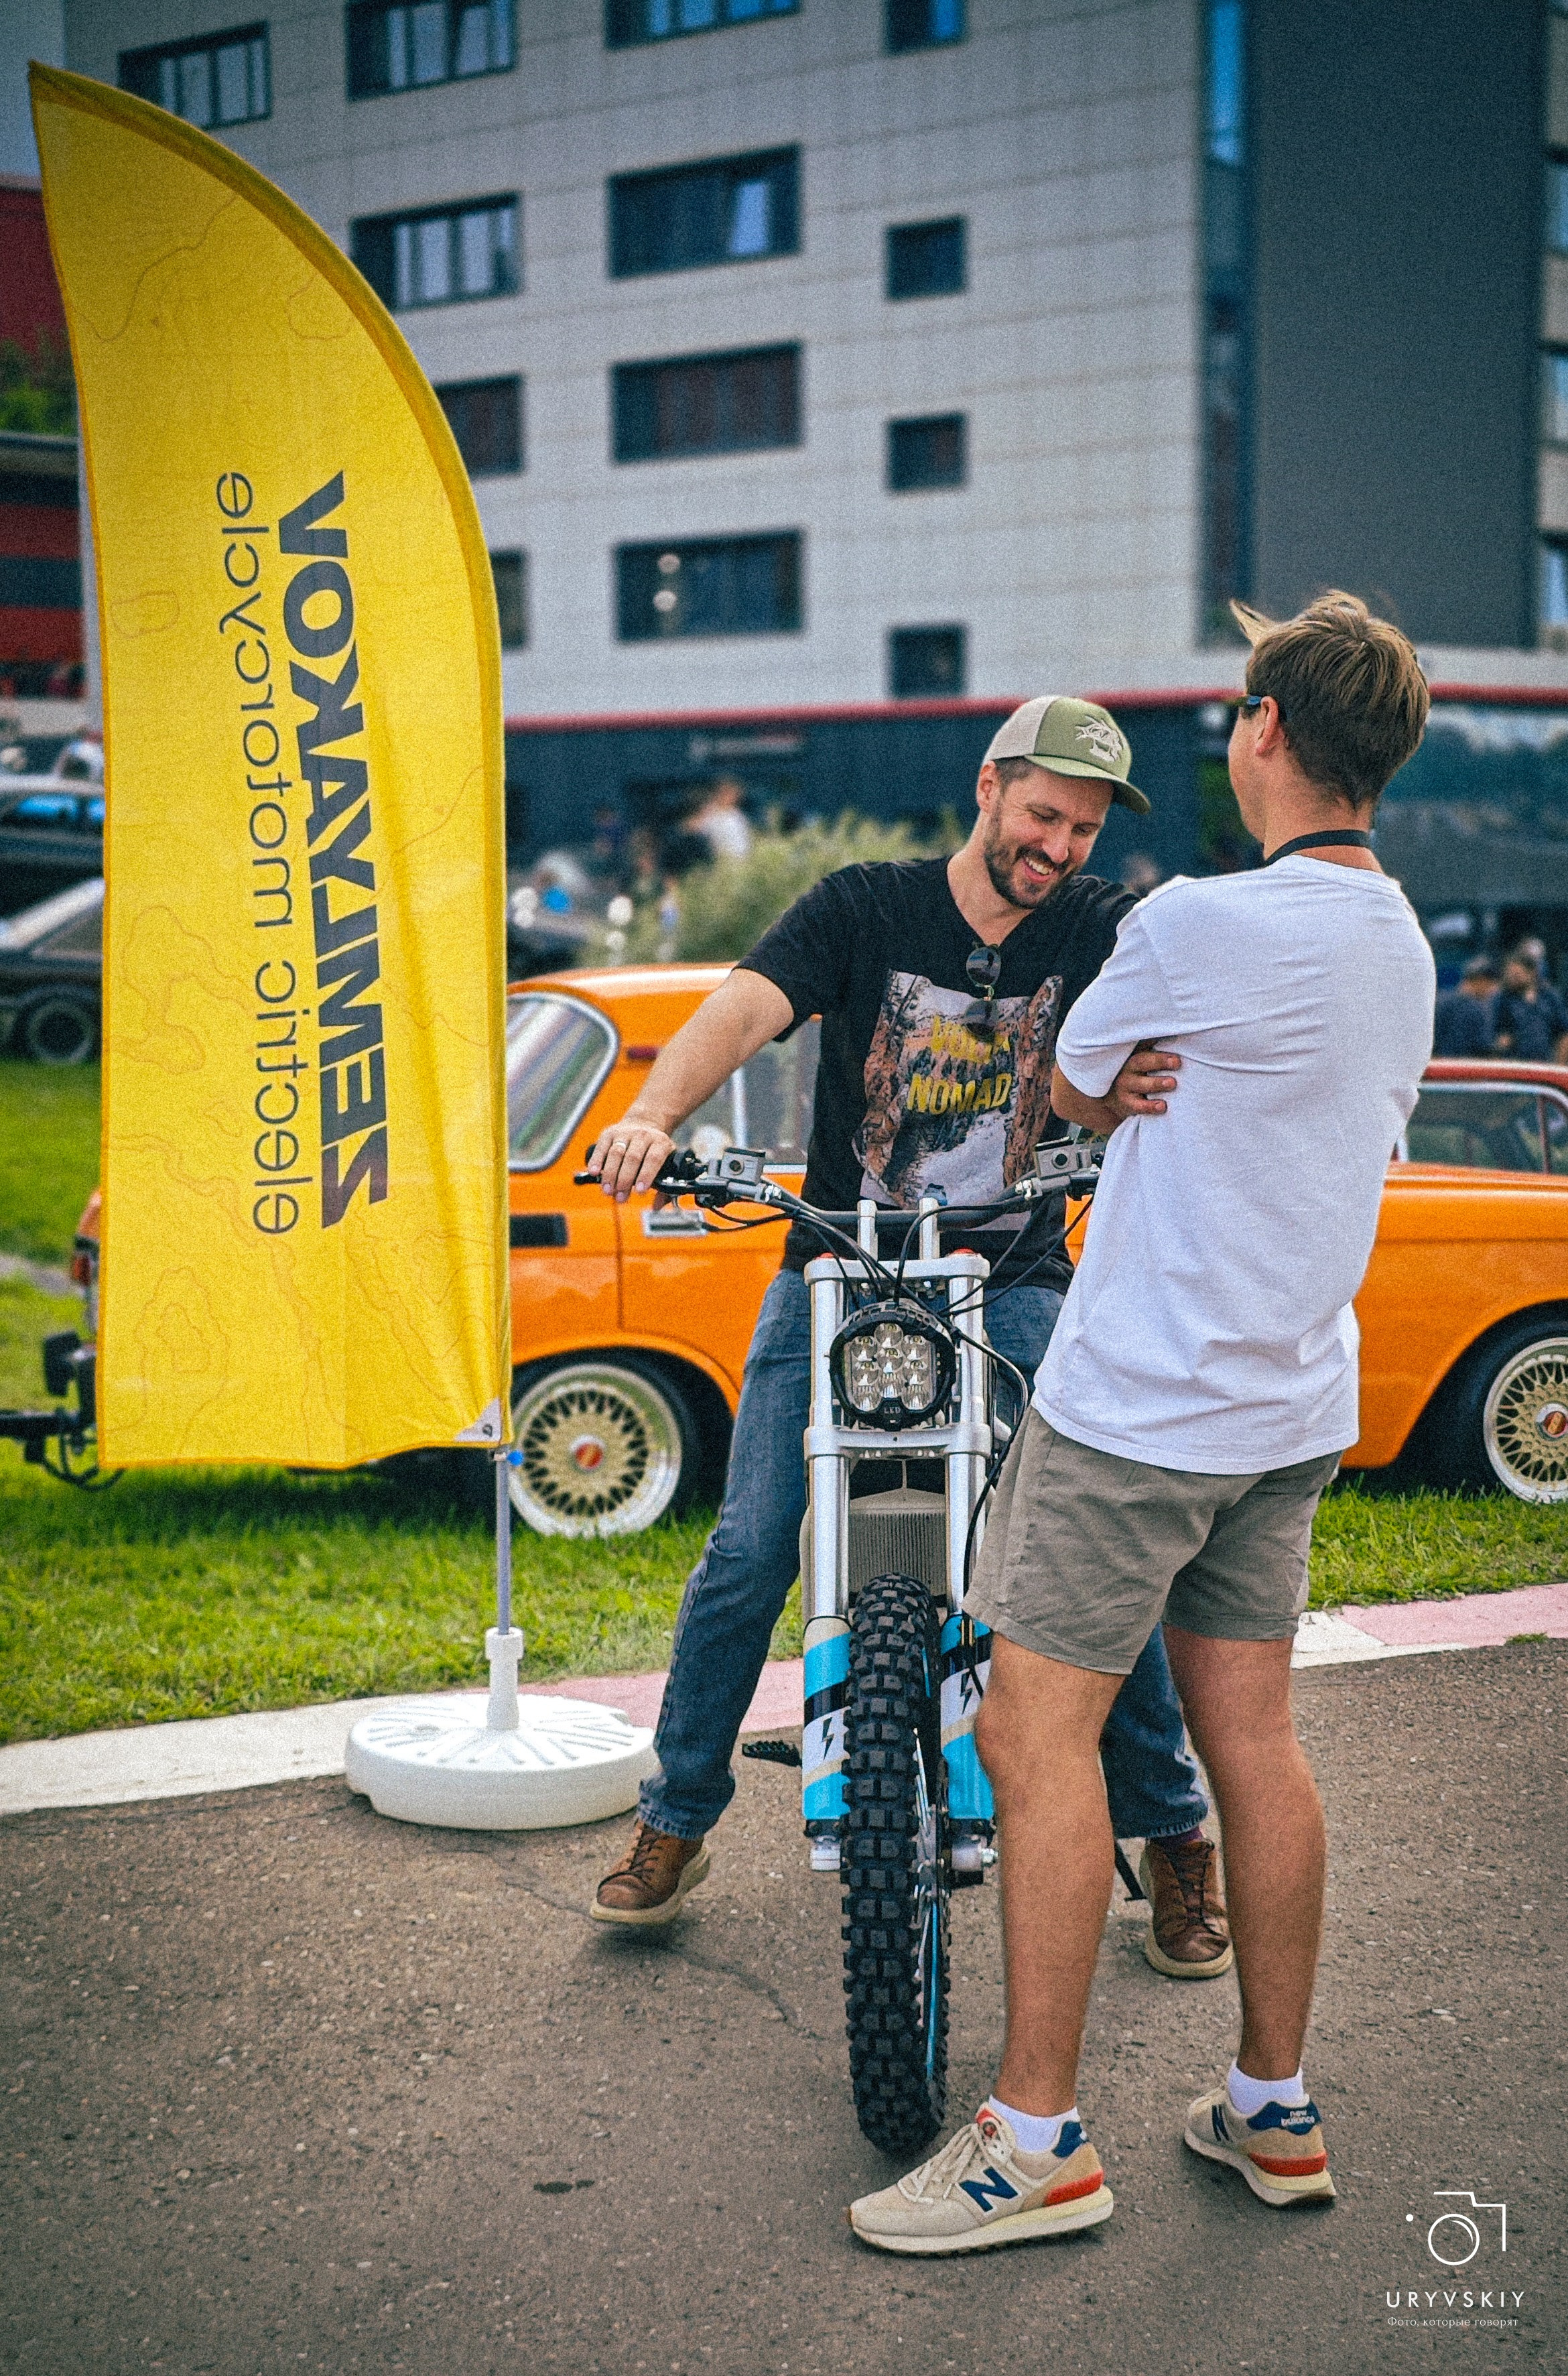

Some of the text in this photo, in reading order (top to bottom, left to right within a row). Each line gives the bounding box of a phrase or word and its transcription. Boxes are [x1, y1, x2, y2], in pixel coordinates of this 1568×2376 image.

[907, 1072, 1012, 1115] NOMAD
[884, 1406, 901, 1414] LED
[1212, 2104, 1230, 2142] N
[959, 2166, 1019, 2212] N
